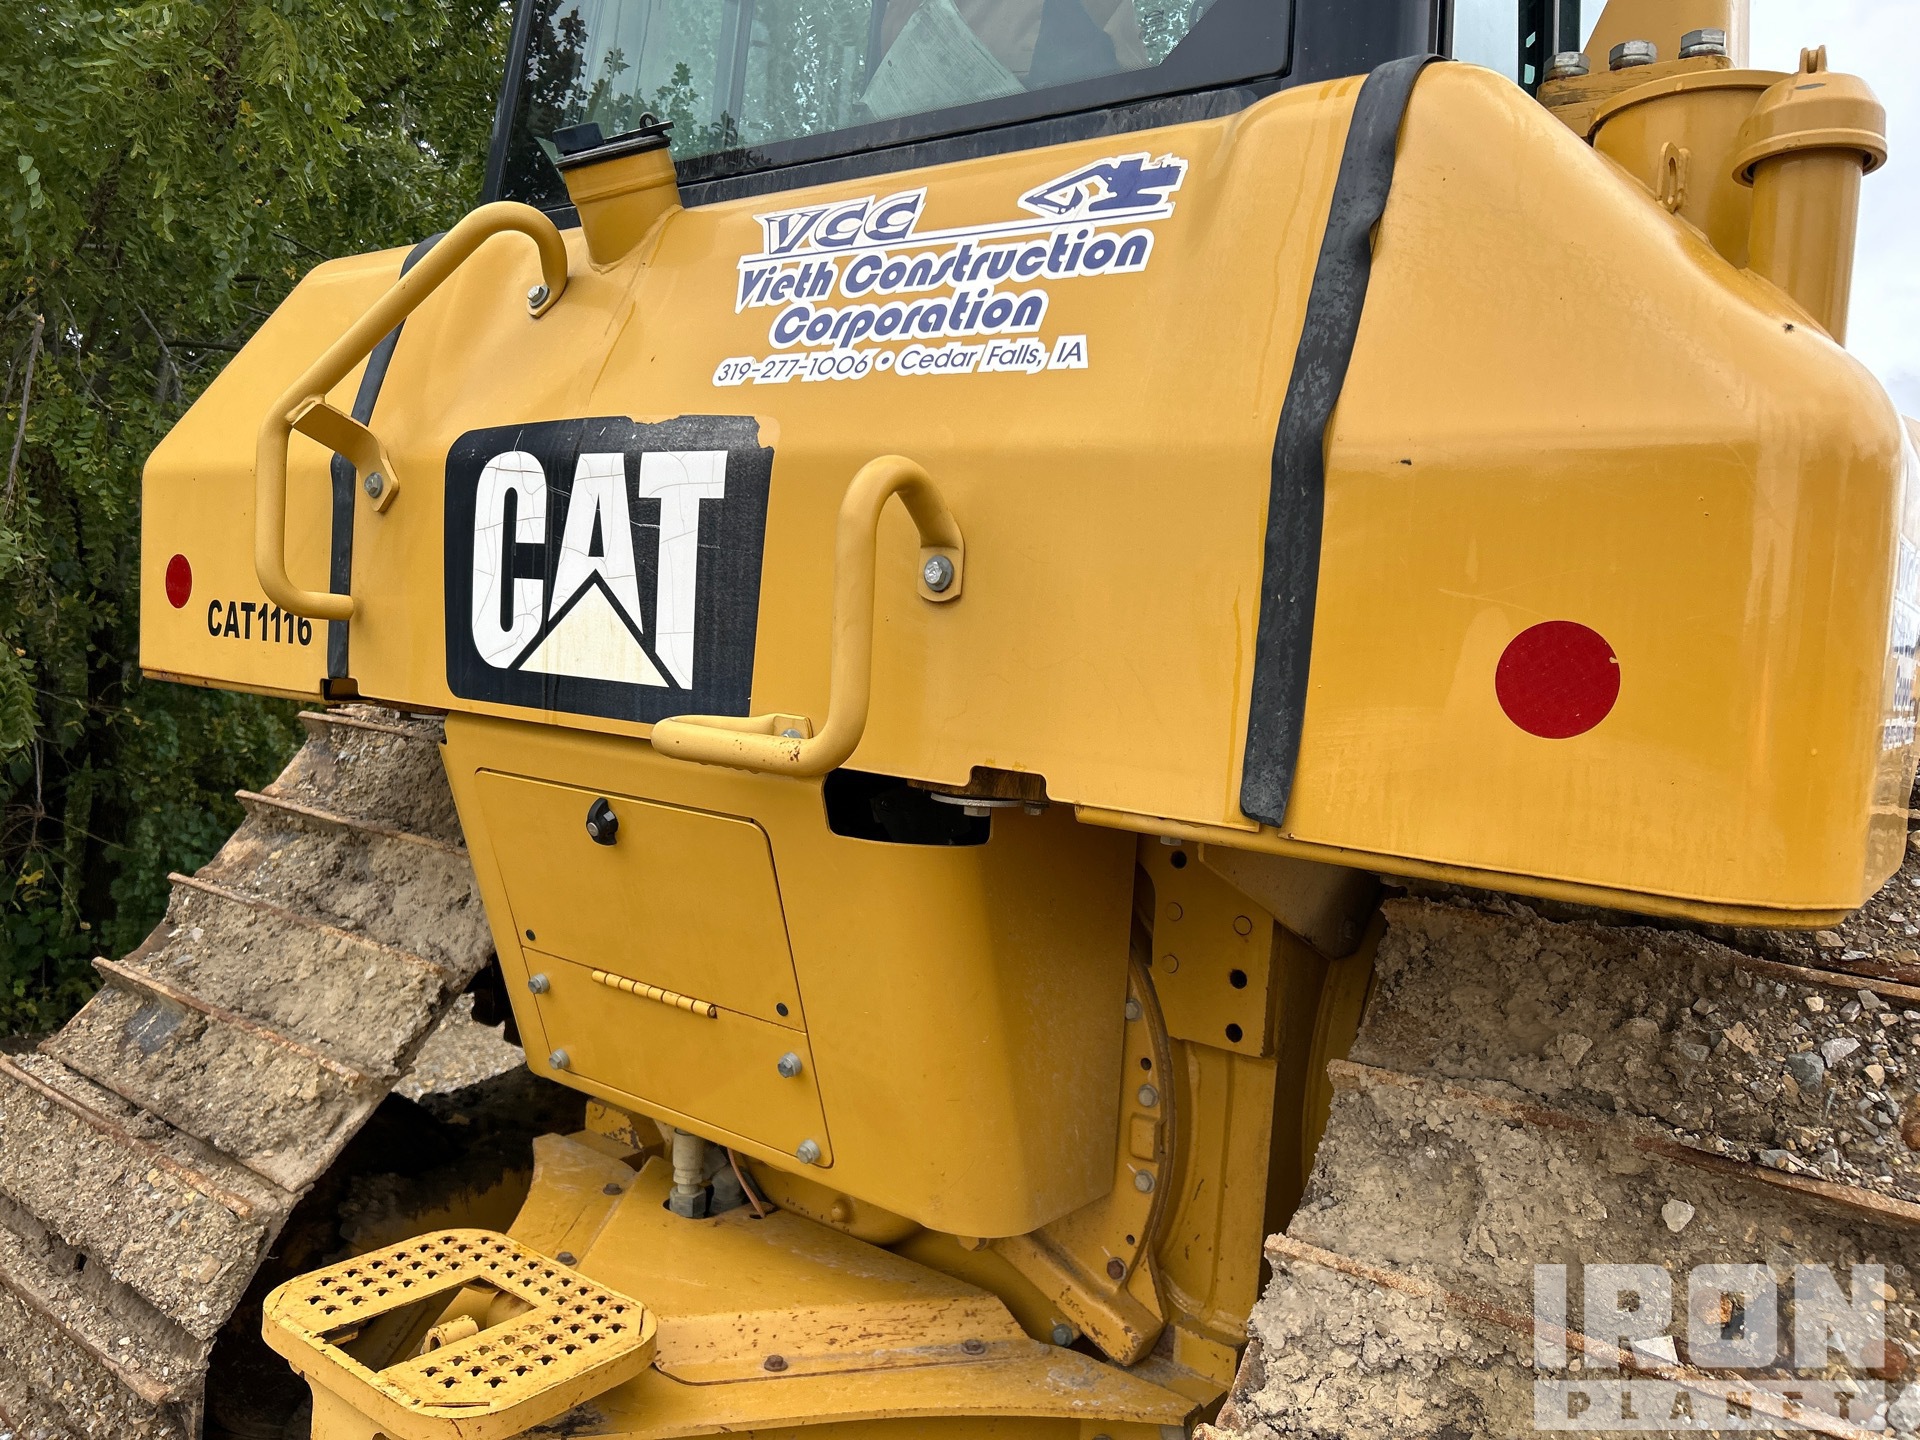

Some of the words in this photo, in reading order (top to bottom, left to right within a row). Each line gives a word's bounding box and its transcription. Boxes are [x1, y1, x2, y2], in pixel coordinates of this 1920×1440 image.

[765, 193, 923, 255] VCC
[741, 259, 833, 305] Vieth
[846, 229, 1149, 293] Construction
[774, 290, 1044, 348] Corporation
[717, 353, 871, 382] 319-277-1006
[900, 348, 978, 370] Cedar
[986, 344, 1044, 368] Falls,
[1056, 341, 1083, 364] IA
[472, 450, 729, 690] CAT
[207, 599, 312, 646] CAT1116
